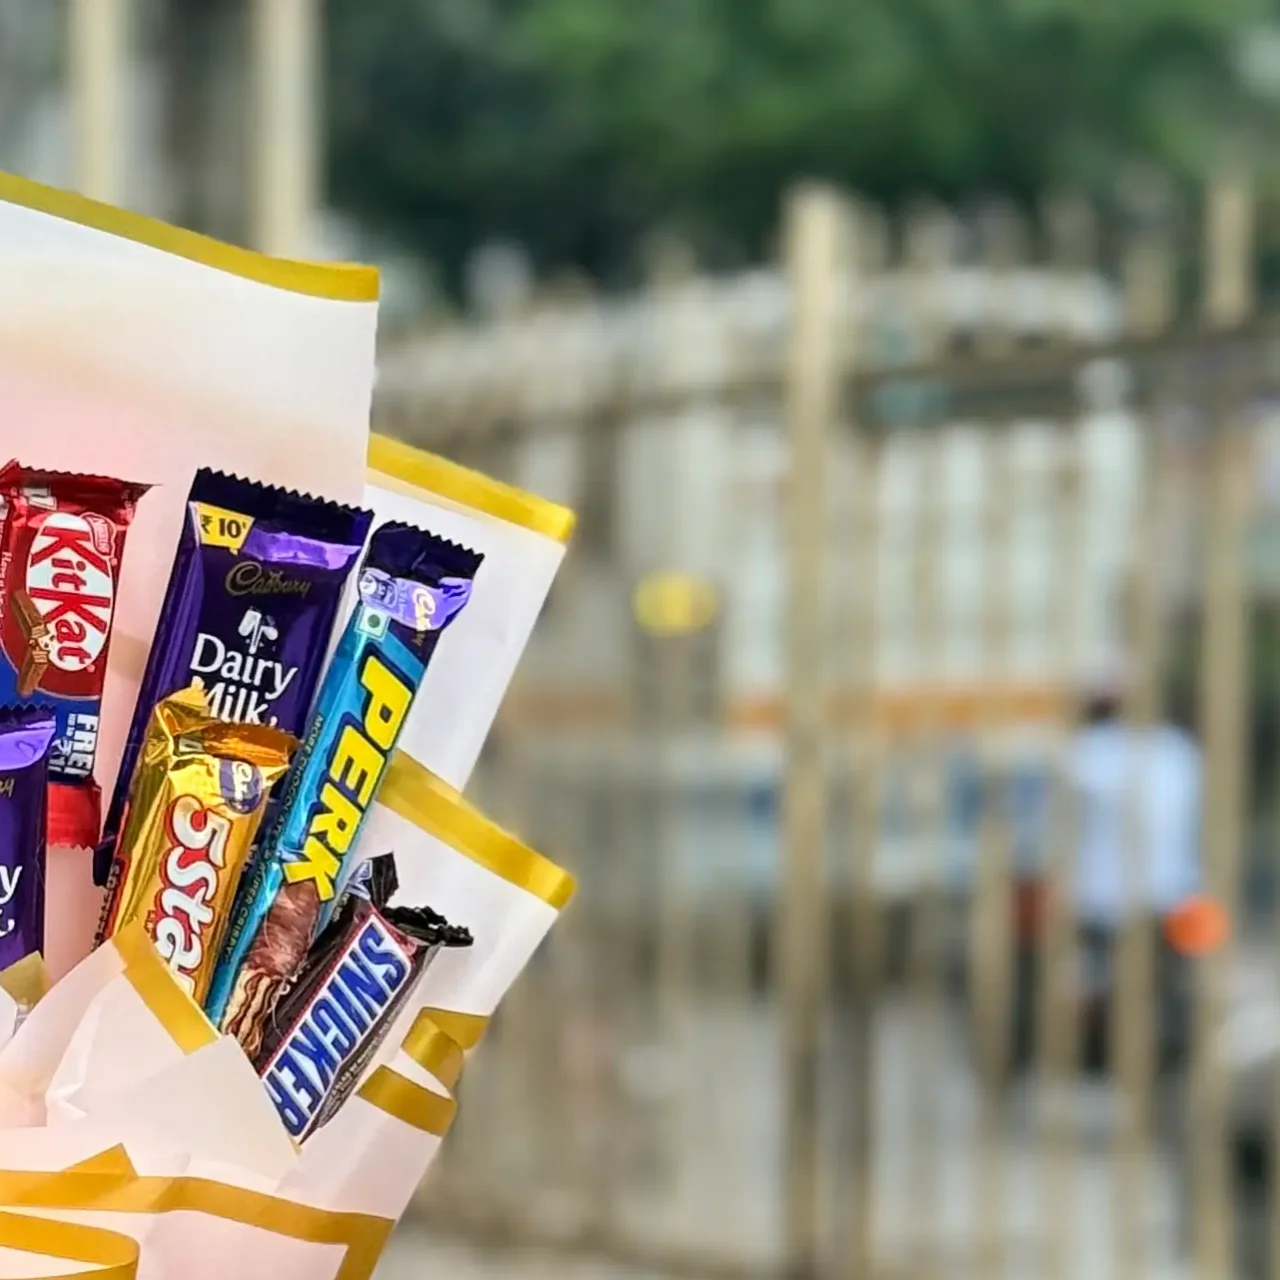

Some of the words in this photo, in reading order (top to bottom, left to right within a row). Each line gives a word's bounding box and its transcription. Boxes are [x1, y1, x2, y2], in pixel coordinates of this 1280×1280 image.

[225, 561, 311, 597] Cadbury
[189, 632, 298, 700] Dairy
[284, 654, 414, 902] PERK
